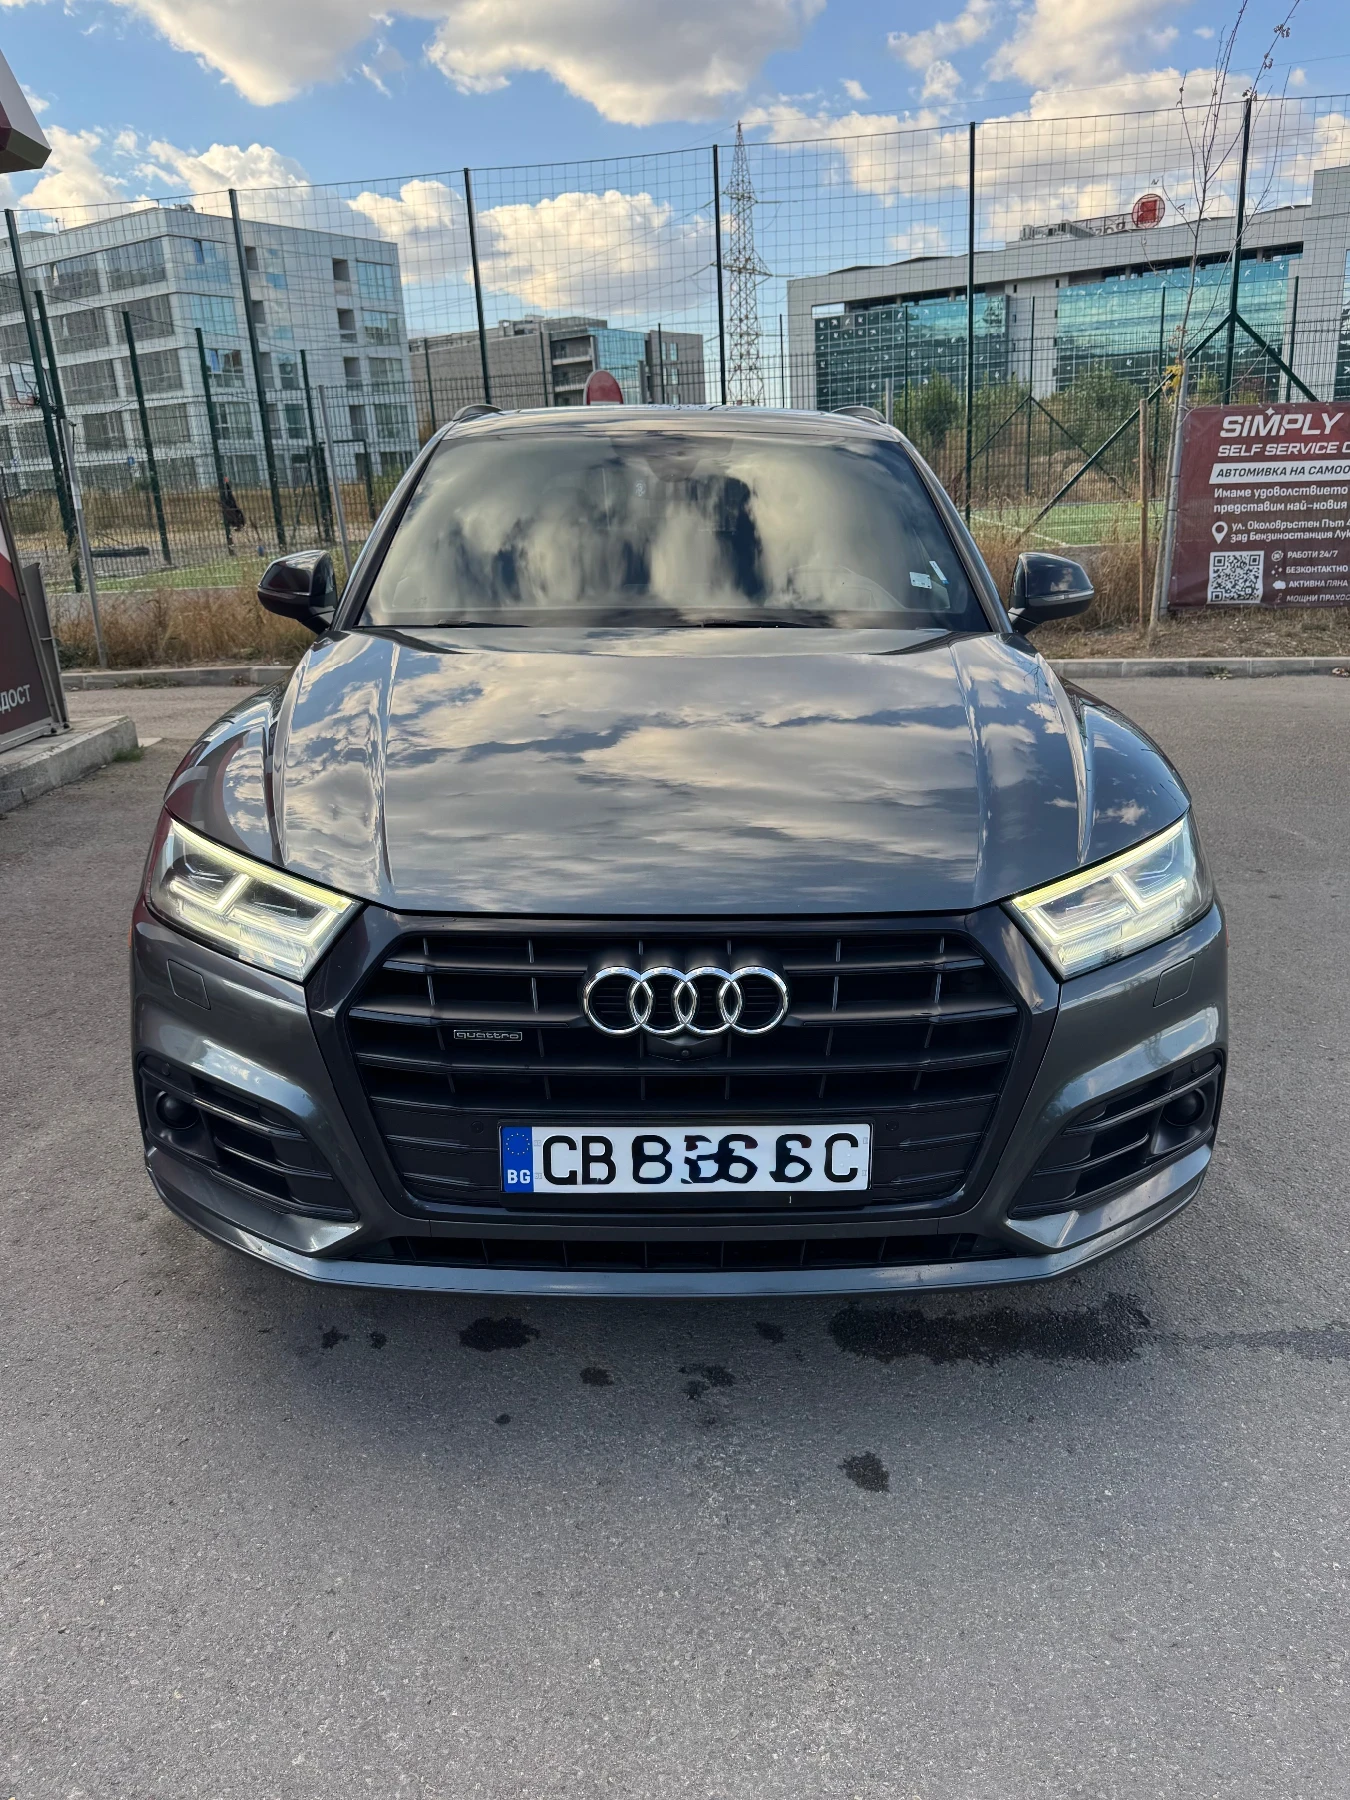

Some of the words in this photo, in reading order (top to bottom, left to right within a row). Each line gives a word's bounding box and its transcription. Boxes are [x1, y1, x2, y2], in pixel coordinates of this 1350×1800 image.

[1220, 412, 1344, 437] SIMPLY
[1218, 444, 1263, 457] SELF
[1265, 442, 1339, 456] SERVICE
[1216, 467, 1287, 478] АВТОМИВКА
[1290, 466, 1305, 476] НА
[1214, 488, 1251, 498] Имаме
[1254, 485, 1348, 499] удоволствието
[1214, 501, 1284, 514] представим
[1287, 500, 1347, 511] най-новия
[1232, 522, 1245, 531] ул.
[1247, 520, 1319, 530] Околовръстен
[1321, 519, 1344, 528] Път
[1230, 533, 1247, 543] зад
[1249, 531, 1332, 542] Бензиностанция
[1287, 551, 1318, 559] РАБОТИ
[1319, 550, 1338, 558] 24/7
[1286, 565, 1348, 574] БЕЗКОНТАКТНО
[1288, 580, 1325, 588] АКТИВНА
[1326, 579, 1348, 587] ПЯНА
[0, 684, 31, 714] ДОСТ
[507, 1169, 531, 1184] BG
